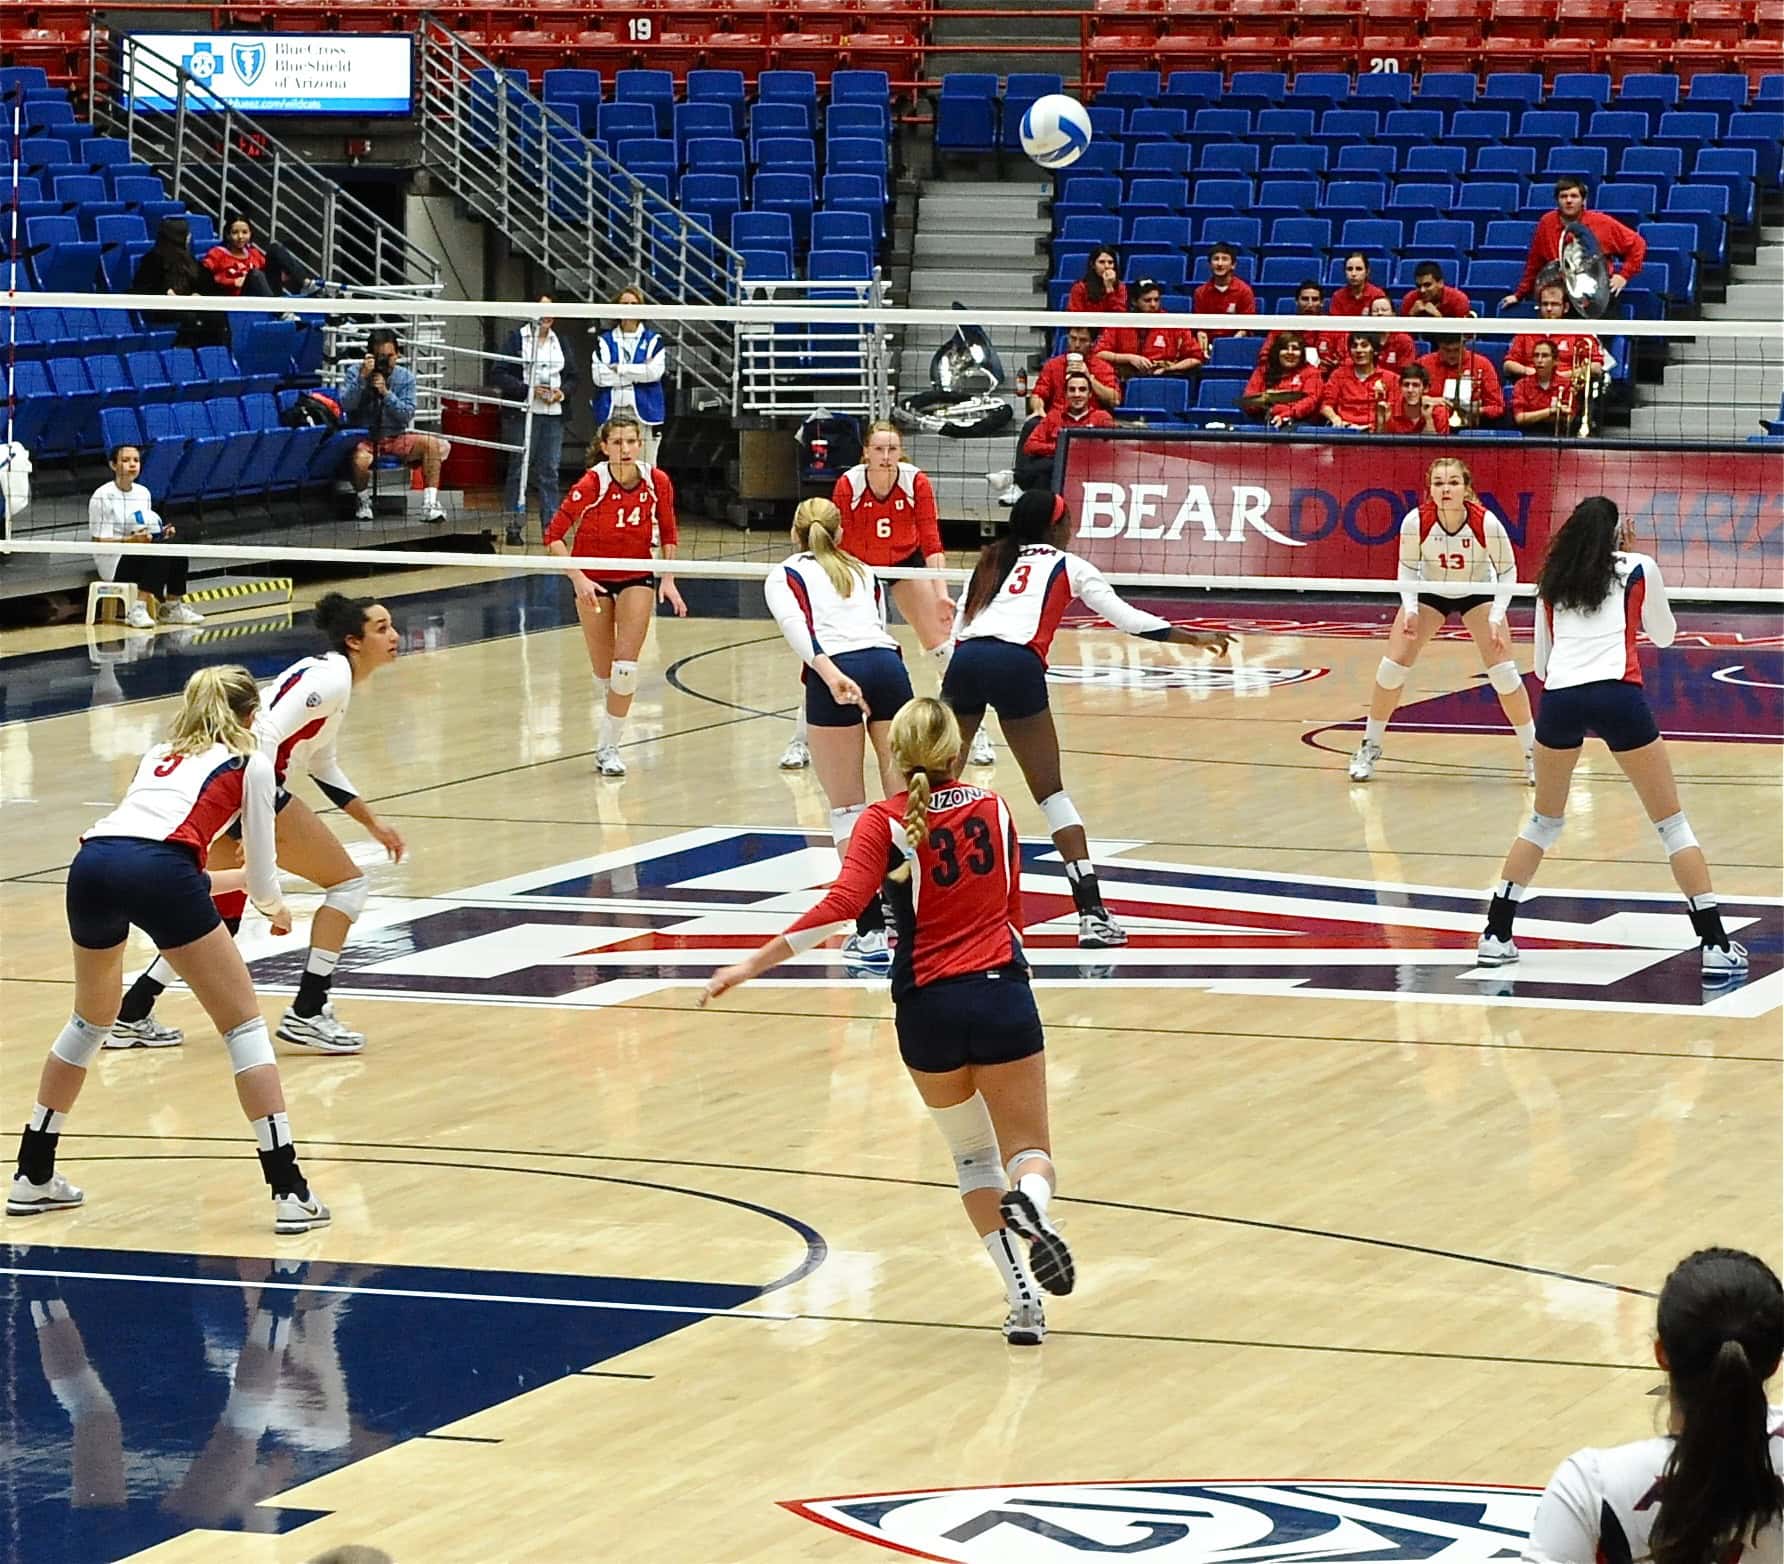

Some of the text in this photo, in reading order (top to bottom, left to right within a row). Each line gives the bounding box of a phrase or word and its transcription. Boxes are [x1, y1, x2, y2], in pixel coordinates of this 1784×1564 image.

[628, 18, 651, 40] 19
[275, 43, 347, 55] BlueCross
[275, 60, 351, 72] BlueShield
[1370, 58, 1399, 74] 20
[275, 77, 347, 89] of Arizona
[615, 506, 641, 528] 14
[1076, 482, 1308, 547] BEAR
[876, 517, 891, 538] 6
[1438, 553, 1465, 570] 13
[1009, 565, 1031, 595] 3
[929, 815, 995, 887] 33
